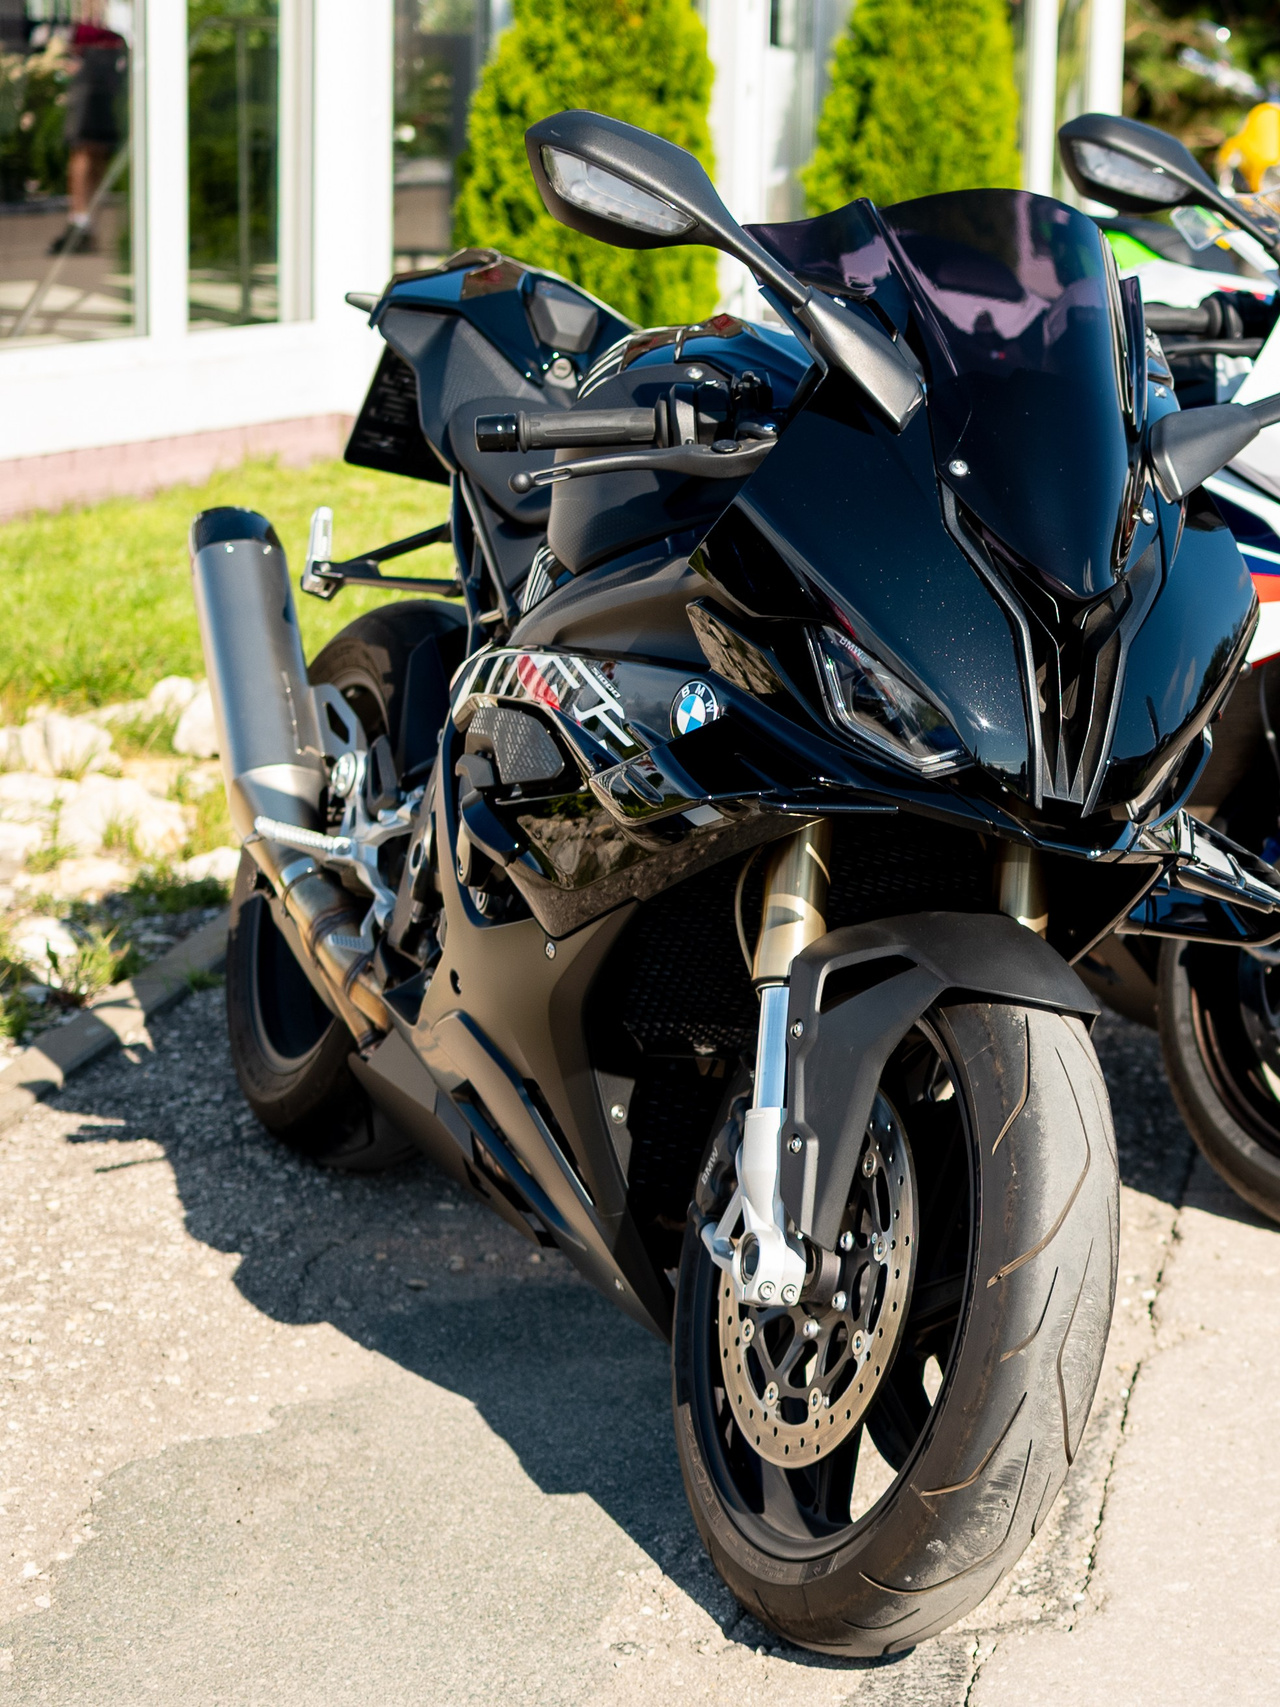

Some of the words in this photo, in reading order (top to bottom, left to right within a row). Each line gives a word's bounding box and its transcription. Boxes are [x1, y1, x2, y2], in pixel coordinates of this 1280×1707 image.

[839, 636, 864, 658] BMW
[681, 685, 715, 713] BMW
[701, 1146, 719, 1185] BMW
